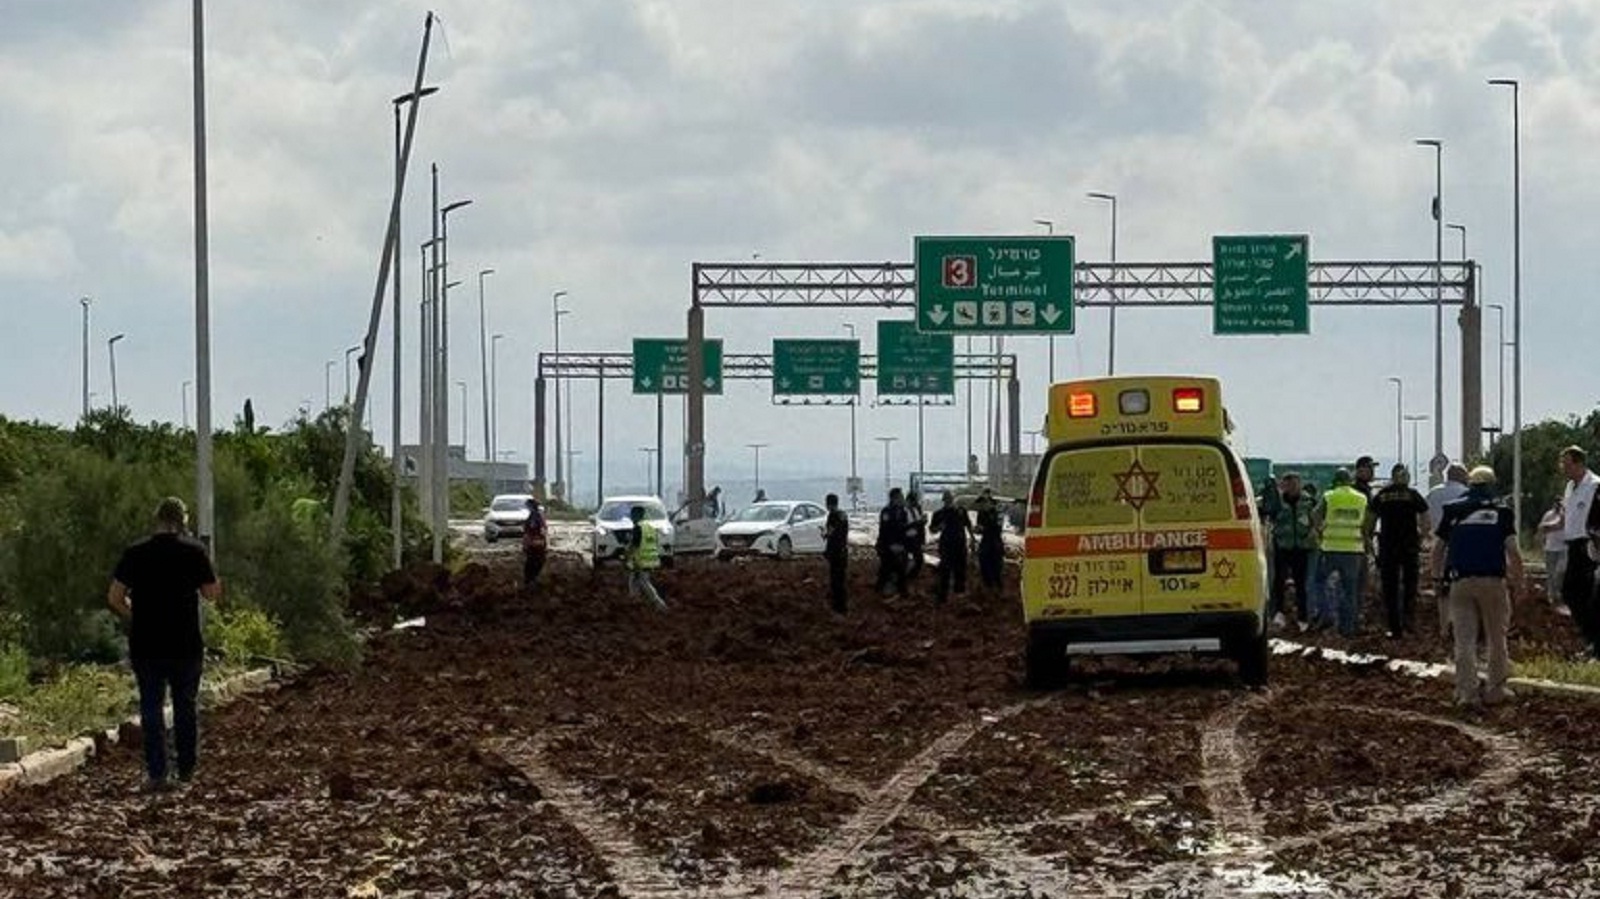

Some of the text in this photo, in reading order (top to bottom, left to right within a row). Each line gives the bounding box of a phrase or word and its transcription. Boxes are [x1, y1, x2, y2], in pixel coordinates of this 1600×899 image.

[987, 247, 1041, 260] טרמינל
[951, 259, 969, 284] 3
[981, 283, 1047, 296] Terminal
[1078, 532, 1208, 551] AMBULANCE
[1158, 577, 1187, 592] 101
